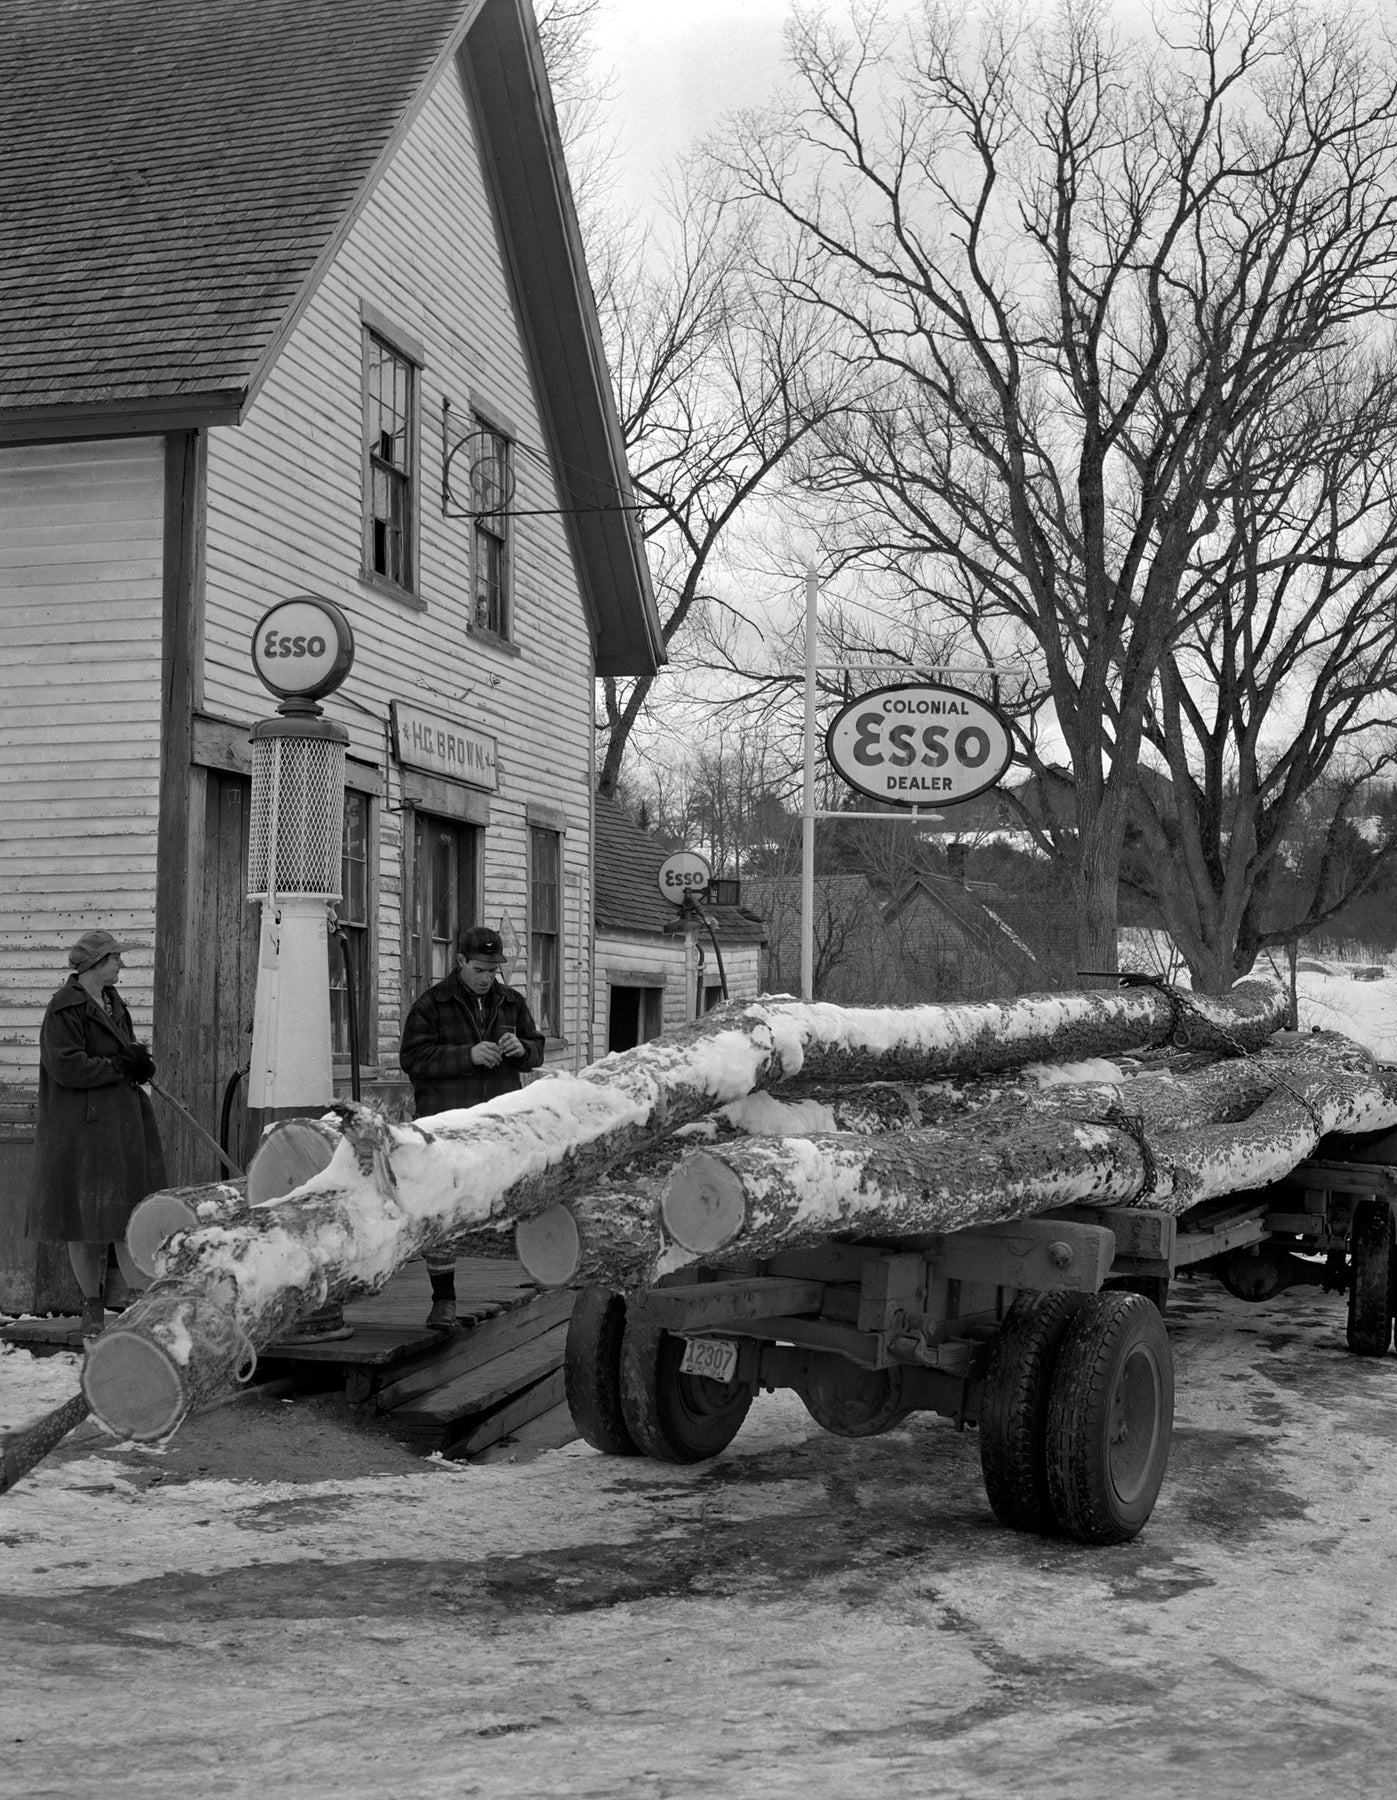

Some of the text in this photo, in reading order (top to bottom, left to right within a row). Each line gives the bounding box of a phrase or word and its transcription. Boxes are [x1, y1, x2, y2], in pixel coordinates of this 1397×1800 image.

[882, 700, 969, 715] COLONIAL
[886, 776, 953, 790] DEALER
[686, 1341, 734, 1371] 12307
